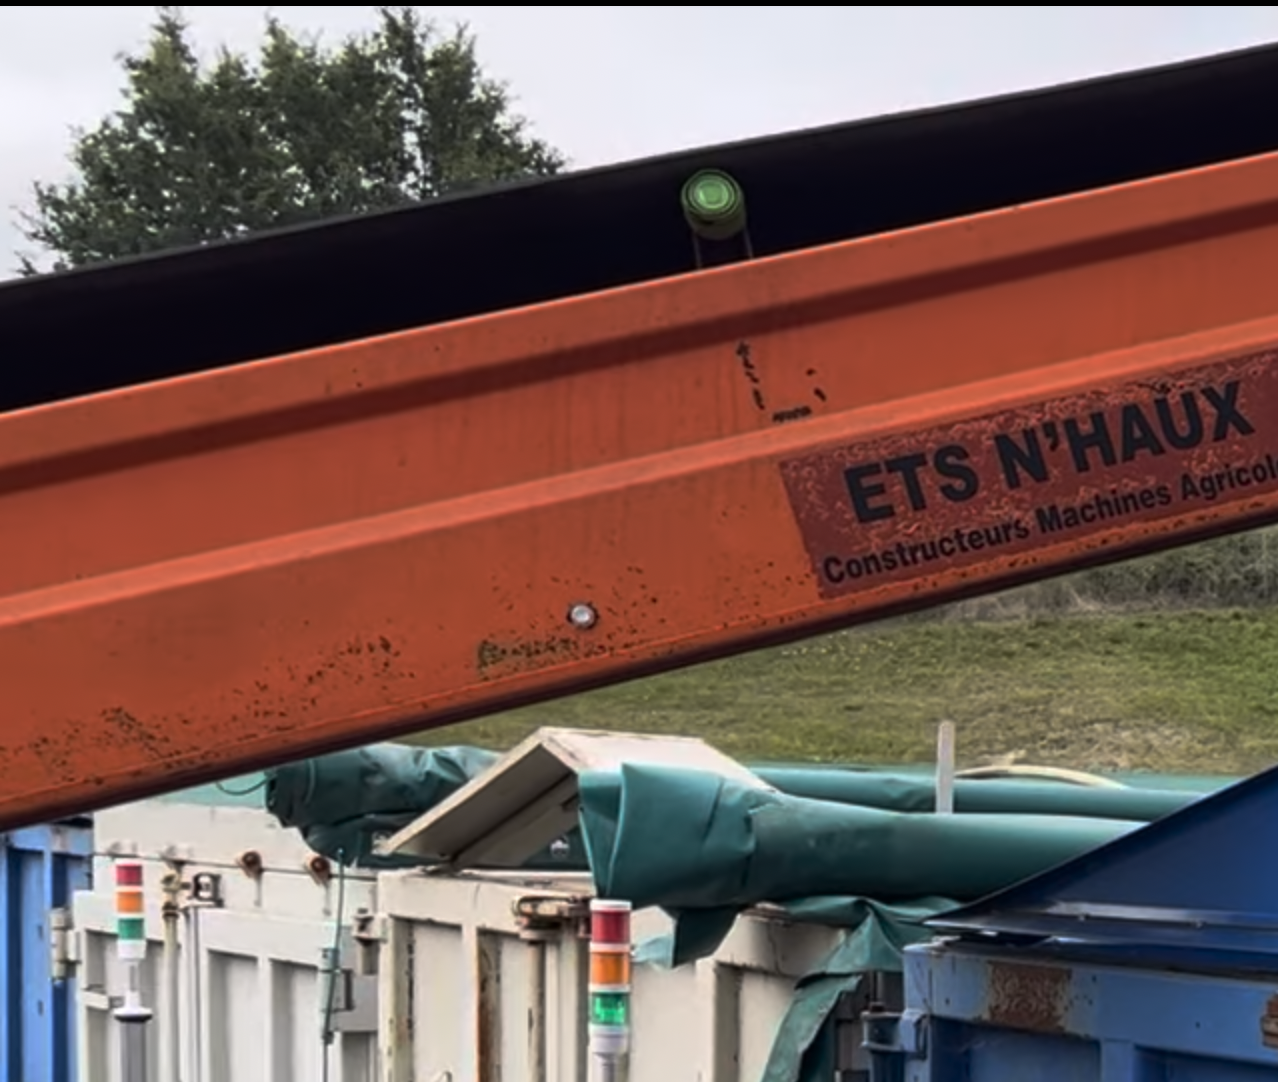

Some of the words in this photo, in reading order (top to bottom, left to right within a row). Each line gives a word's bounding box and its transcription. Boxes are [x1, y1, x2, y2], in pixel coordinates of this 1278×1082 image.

[844, 444, 980, 524] ETS
[824, 518, 1030, 584] Constructeurs
[1035, 484, 1171, 534] Machines
